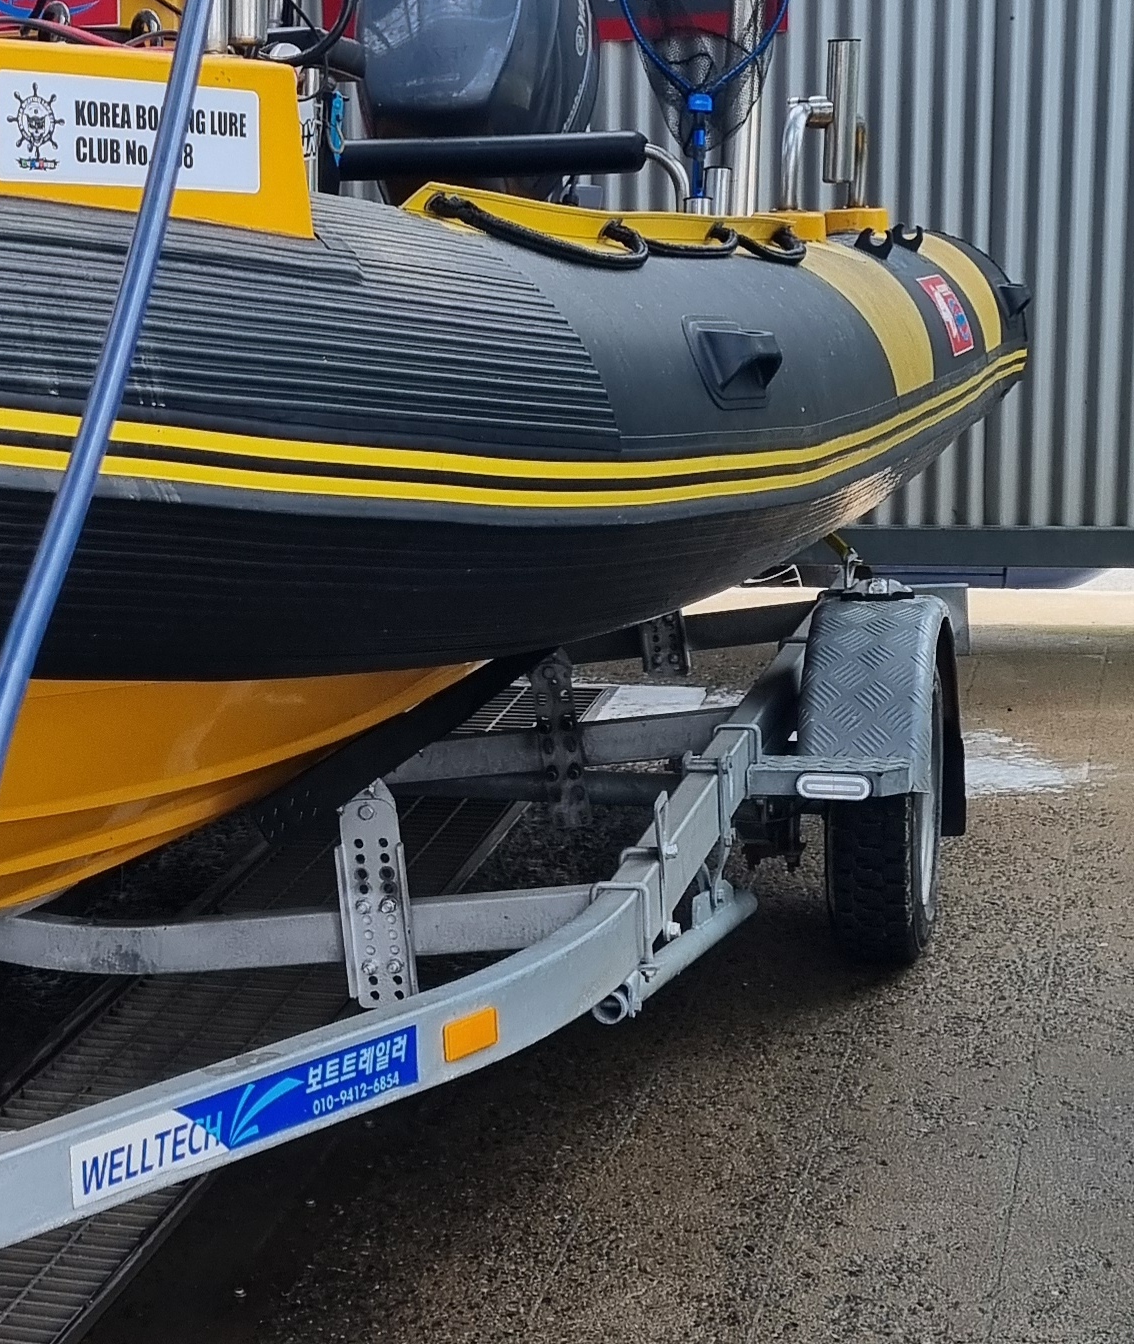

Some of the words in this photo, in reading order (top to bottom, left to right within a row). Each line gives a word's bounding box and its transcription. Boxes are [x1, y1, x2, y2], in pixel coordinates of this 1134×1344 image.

[75, 100, 132, 129] KOREA
[210, 111, 248, 138] LURE
[75, 136, 121, 165] CLUB
[305, 1033, 408, 1094] 보트트레일러
[312, 1070, 400, 1115] 010-9412-6854
[81, 1110, 223, 1195] WELLTECH
